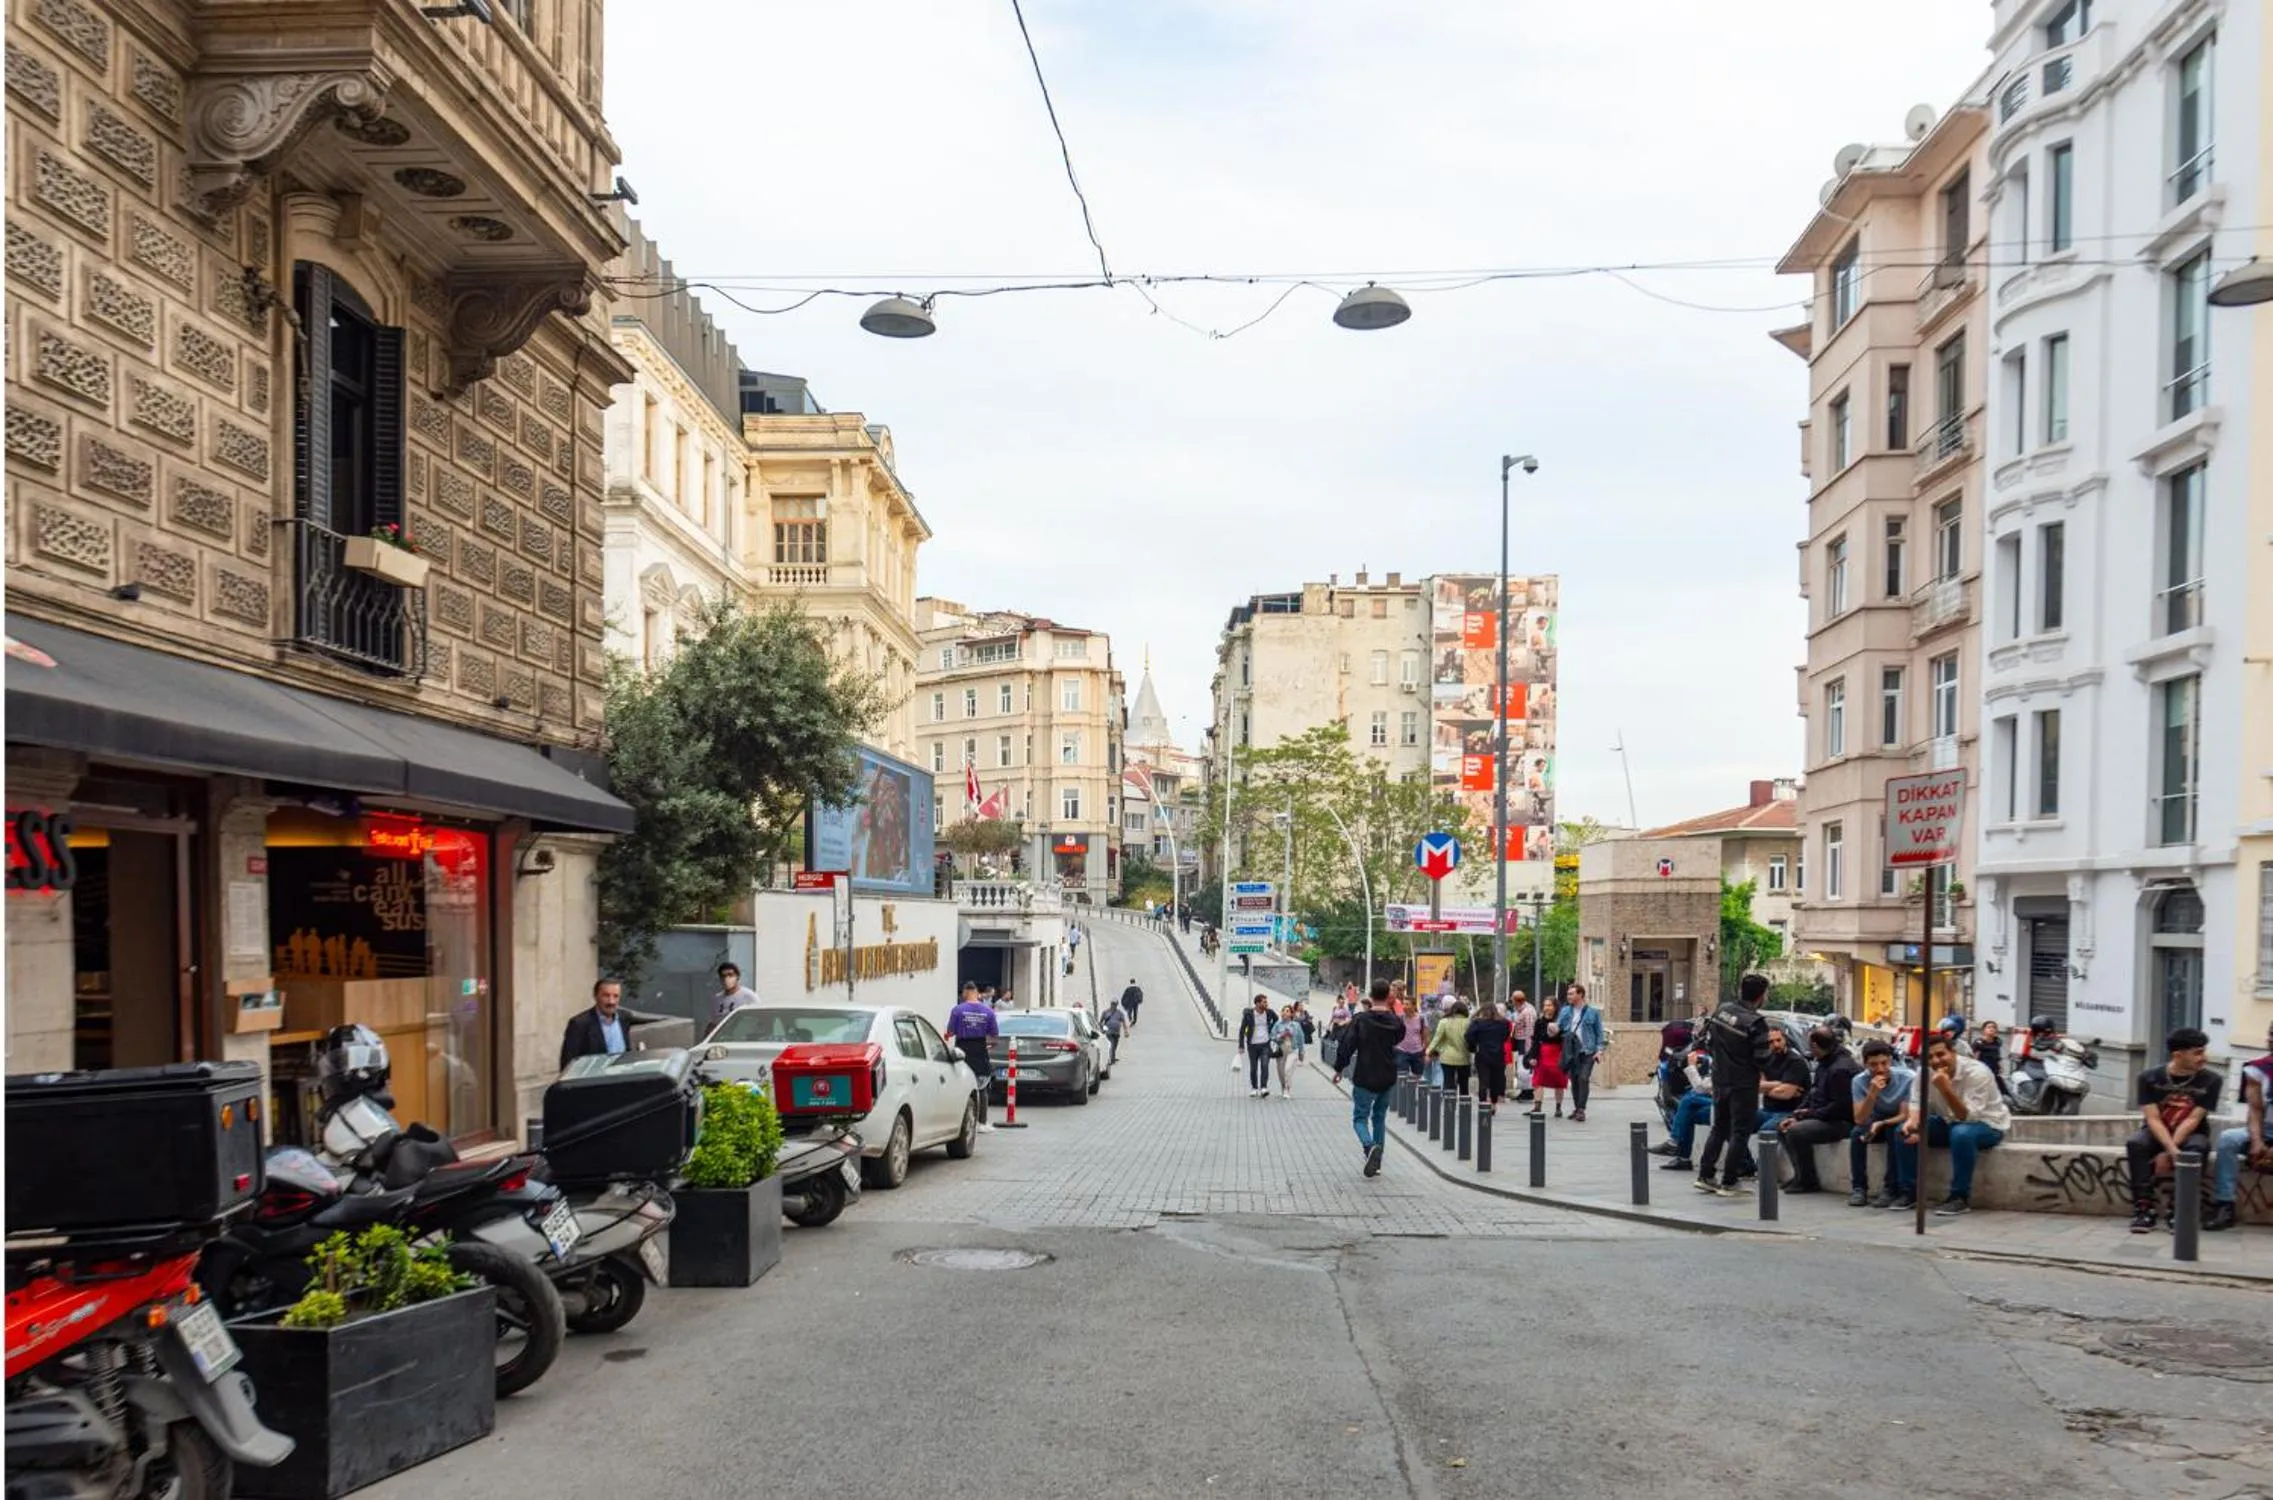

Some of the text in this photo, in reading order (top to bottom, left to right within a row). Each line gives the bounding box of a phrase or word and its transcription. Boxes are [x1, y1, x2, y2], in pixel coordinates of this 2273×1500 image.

[1897, 781, 1960, 804] DİKKAT
[1898, 804, 1957, 824] KAPAN
[1911, 827, 1946, 843] VAR
[375, 861, 407, 884] all
[373, 895, 417, 917] eat
